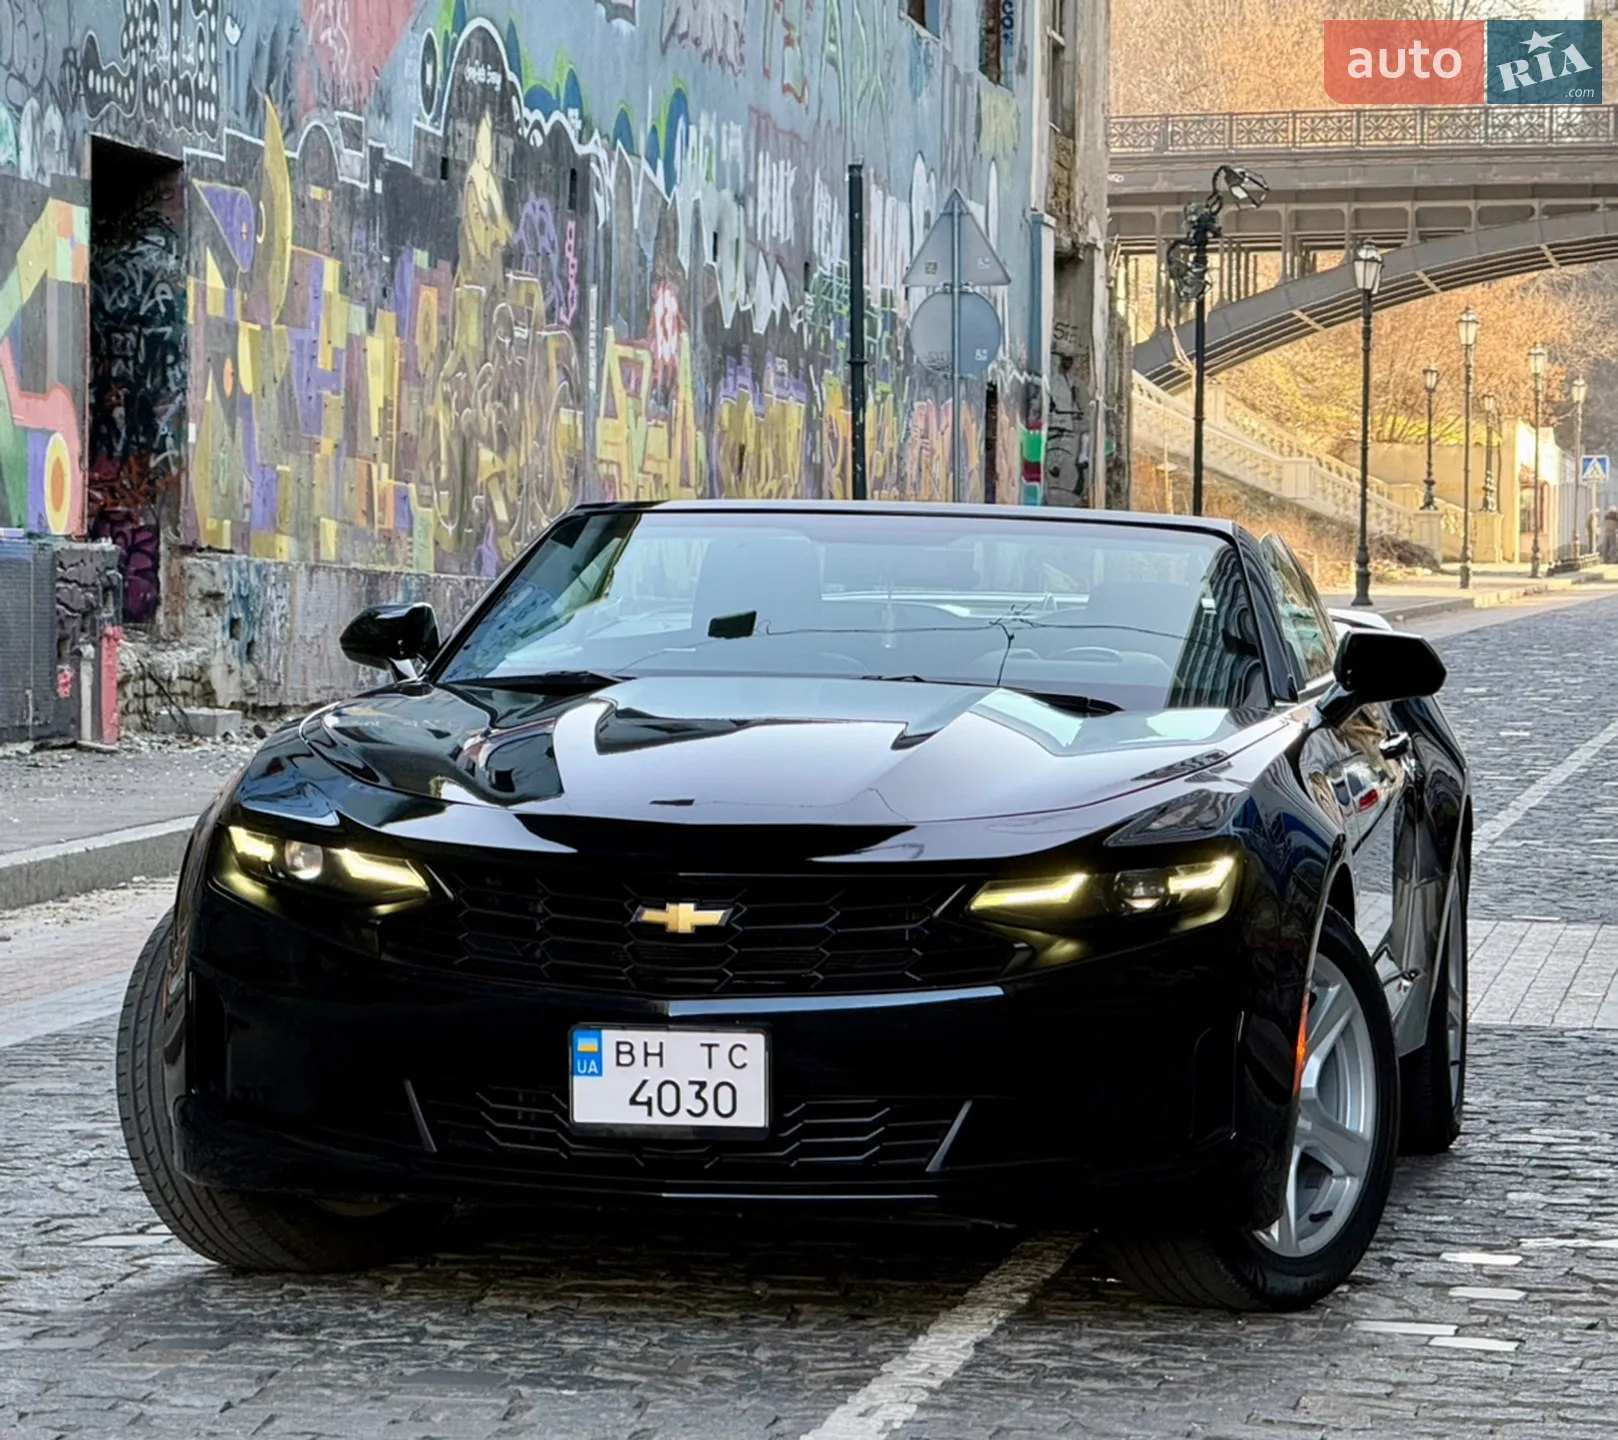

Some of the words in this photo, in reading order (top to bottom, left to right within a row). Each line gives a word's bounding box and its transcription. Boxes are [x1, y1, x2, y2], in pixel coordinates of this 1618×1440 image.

[577, 1060, 598, 1074] UA
[615, 1041, 664, 1068] BH
[700, 1043, 748, 1070] TC
[629, 1079, 737, 1118] 4030
